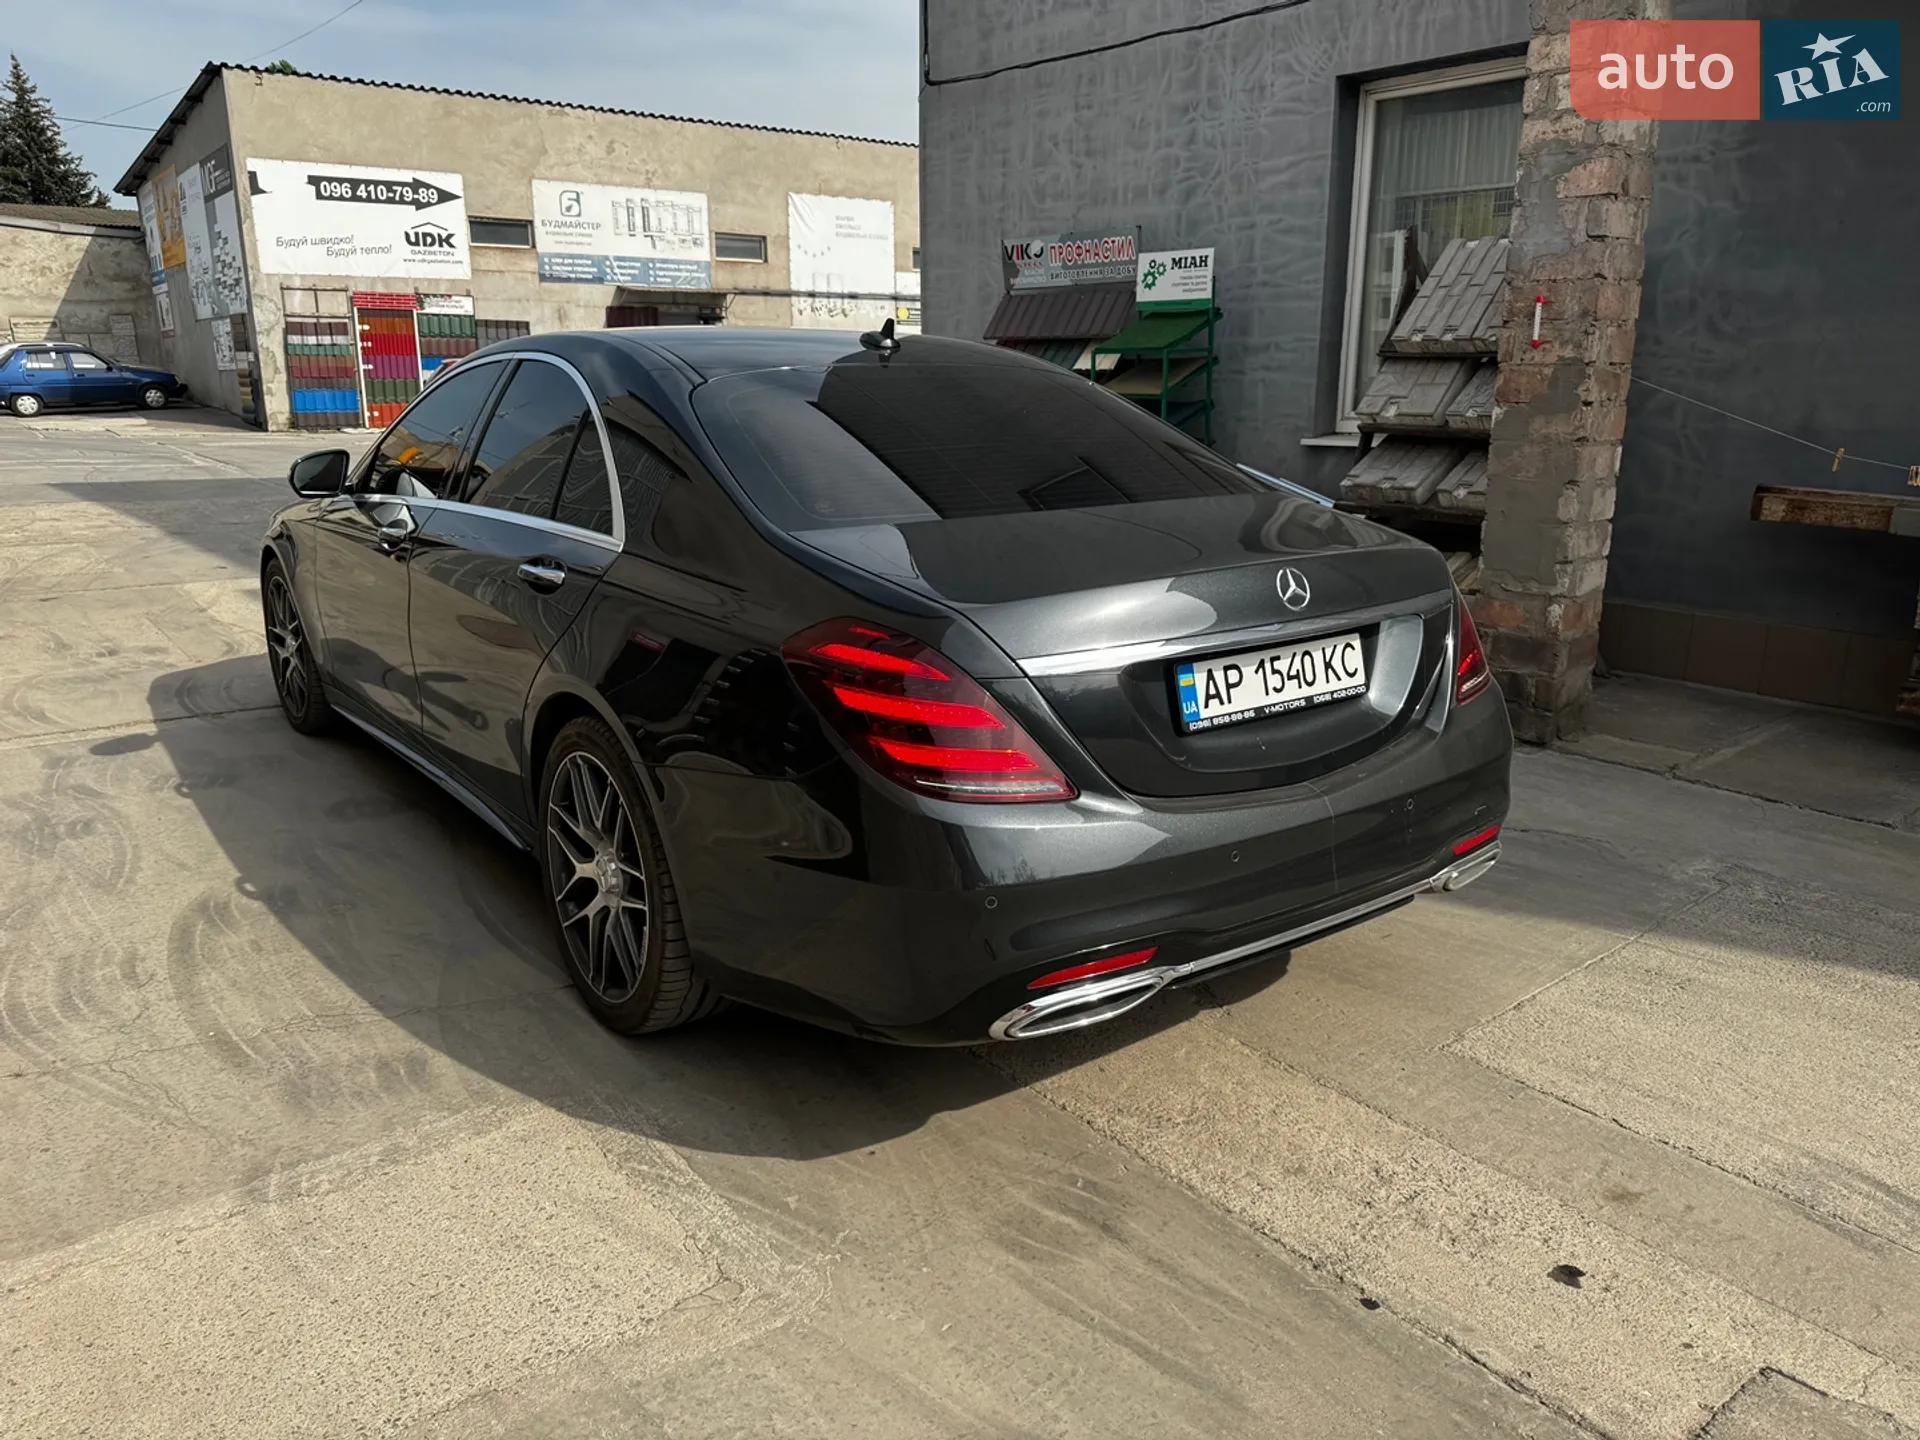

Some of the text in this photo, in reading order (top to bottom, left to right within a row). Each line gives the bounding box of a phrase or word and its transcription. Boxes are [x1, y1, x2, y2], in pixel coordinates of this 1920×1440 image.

[320, 181, 439, 204] 096 410-79-89
[541, 219, 602, 231] БУДМАЙСТЕР
[276, 234, 355, 249] Будуй швидко!
[404, 230, 457, 249] UDK
[326, 244, 392, 259] Будуй тепло!
[410, 249, 455, 257] GAZBETON
[1048, 236, 1136, 267] ПРОФНАСТИЛ
[1050, 265, 1136, 280] ВИГОТОВЛЕННЯ ЗА ДОБУ
[1203, 642, 1358, 709] AP 1540 KC
[1183, 701, 1199, 714] UA
